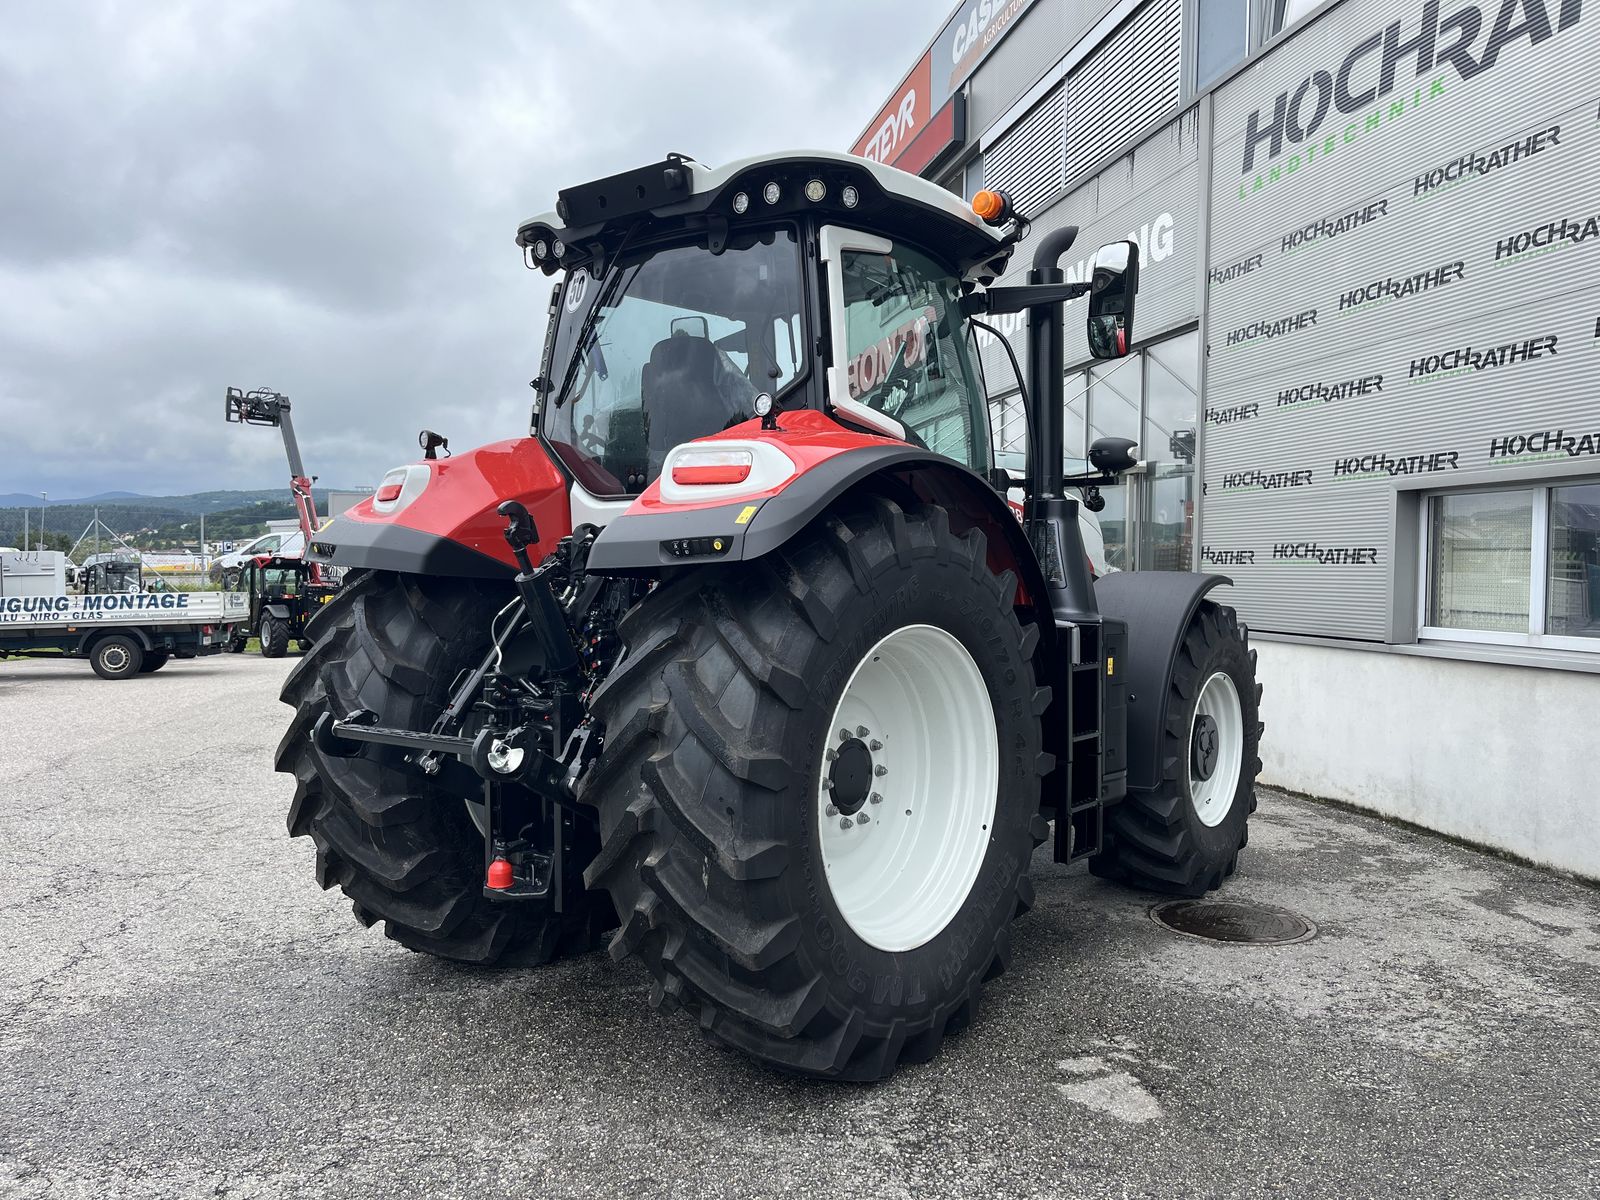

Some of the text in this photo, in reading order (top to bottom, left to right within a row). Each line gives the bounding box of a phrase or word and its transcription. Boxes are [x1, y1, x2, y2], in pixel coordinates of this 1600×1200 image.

[1238, 75, 1447, 200] LANDTECHNIK
[1413, 125, 1561, 197] HOCHRATHER
[1281, 199, 1388, 253] HOCHRATHER
[1495, 216, 1600, 260] HOCHRA
[1339, 261, 1465, 310] HOCHRATHER
[1226, 309, 1318, 346] HOCHRATHER
[1409, 334, 1558, 378] HOCHRATHER
[1277, 374, 1384, 408] HOCHRATHER
[1223, 469, 1313, 489] HOCHRATHER
[1334, 450, 1459, 476] HOCHRATHER
[1272, 542, 1378, 565] HOCHRATHER
[30, 612, 60, 621] NIRO
[72, 611, 103, 620] GLAS
[83, 593, 189, 611] MONTAGE
